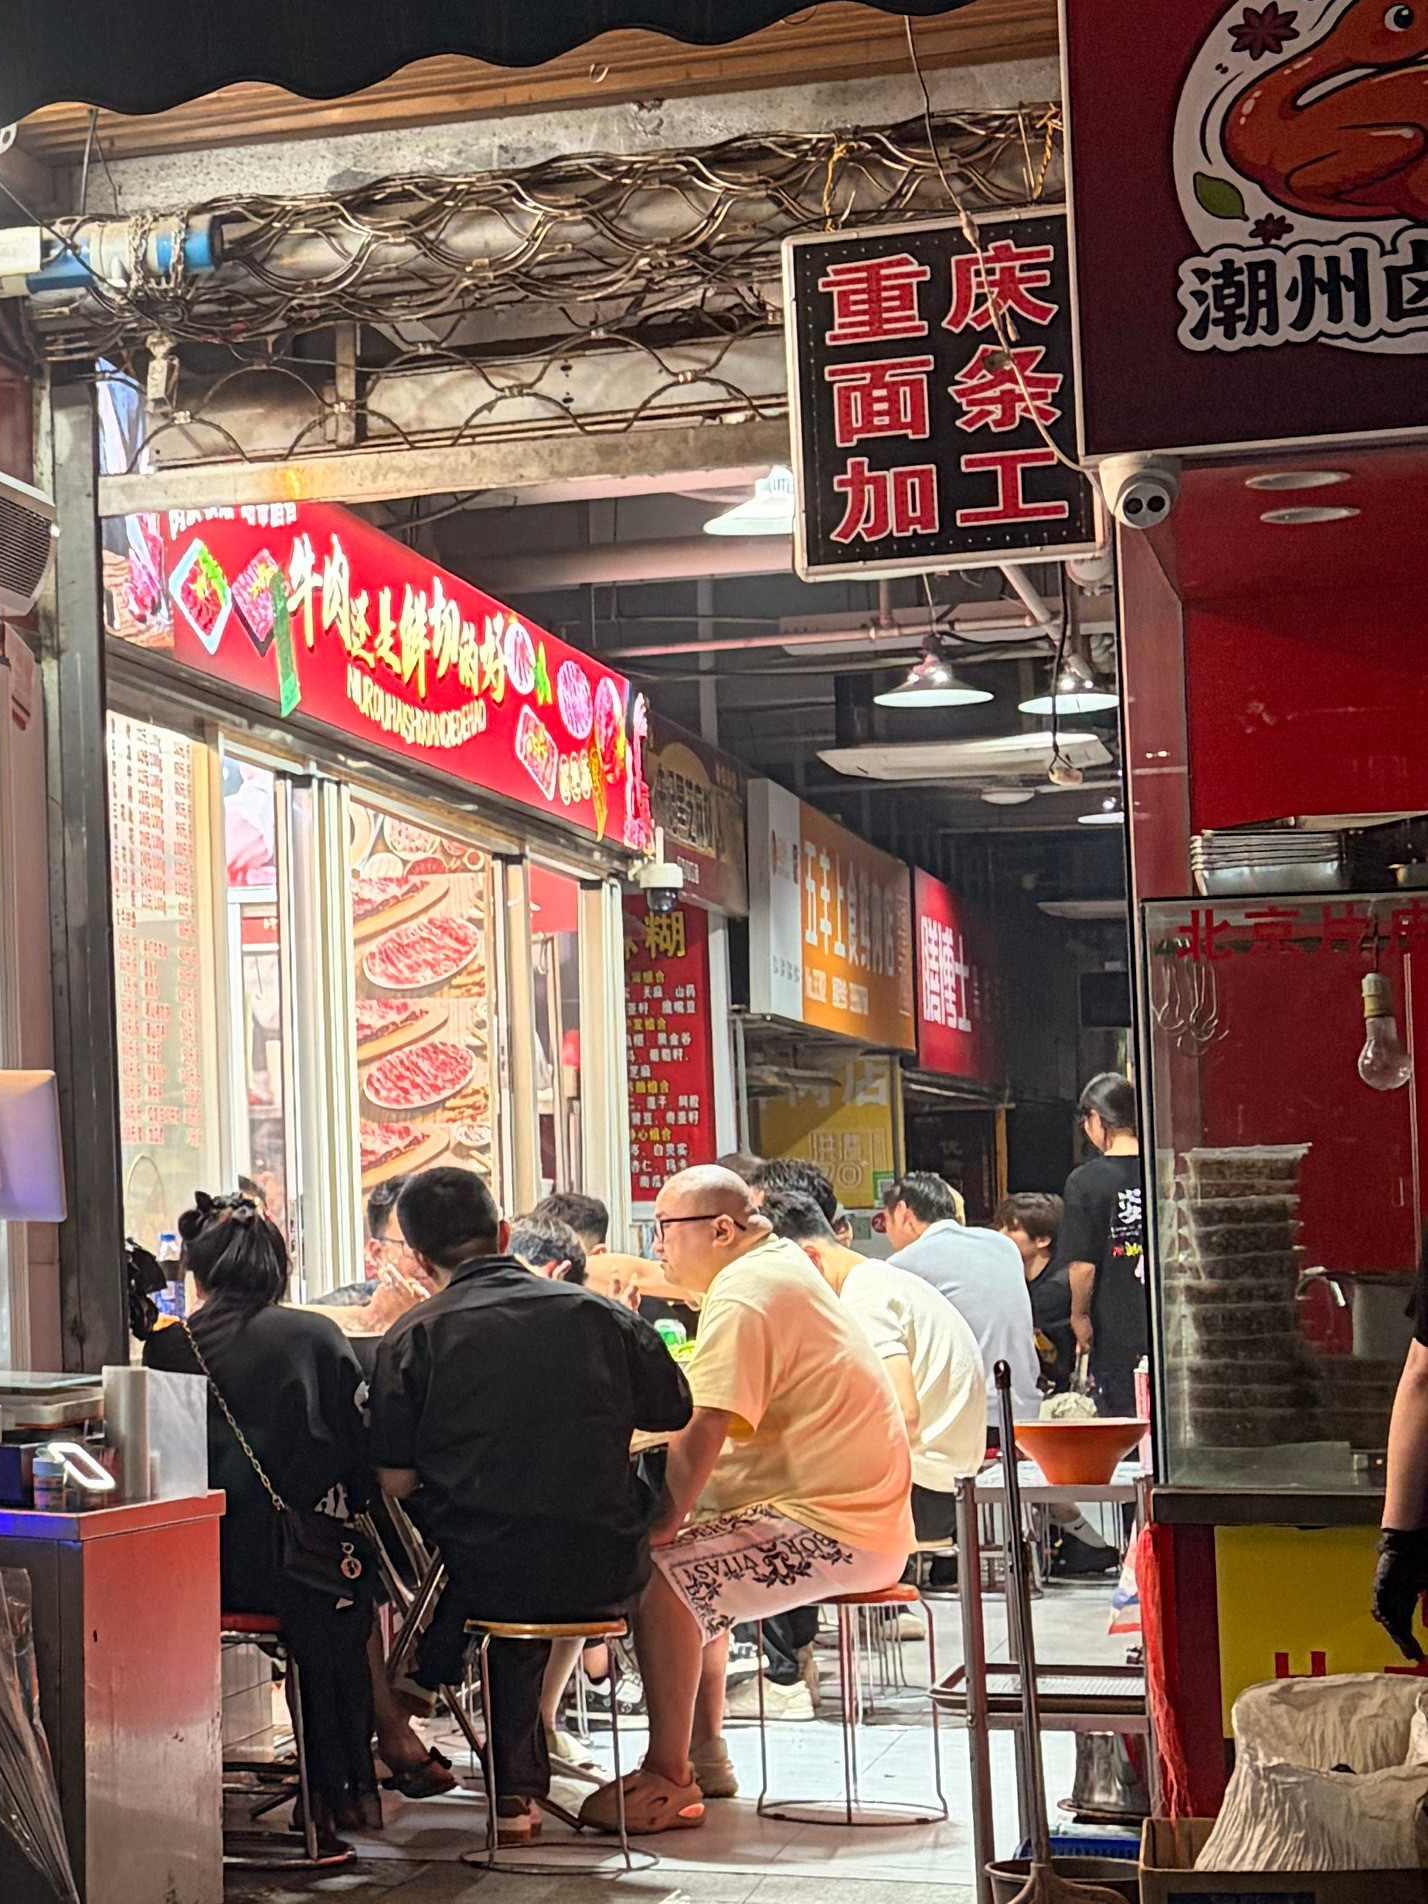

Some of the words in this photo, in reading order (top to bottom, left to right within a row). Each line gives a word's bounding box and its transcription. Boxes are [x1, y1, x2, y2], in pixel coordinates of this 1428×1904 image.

[818, 240, 1059, 346] 重庆
[824, 345, 1065, 446] 面条
[830, 447, 1070, 544] 加工
